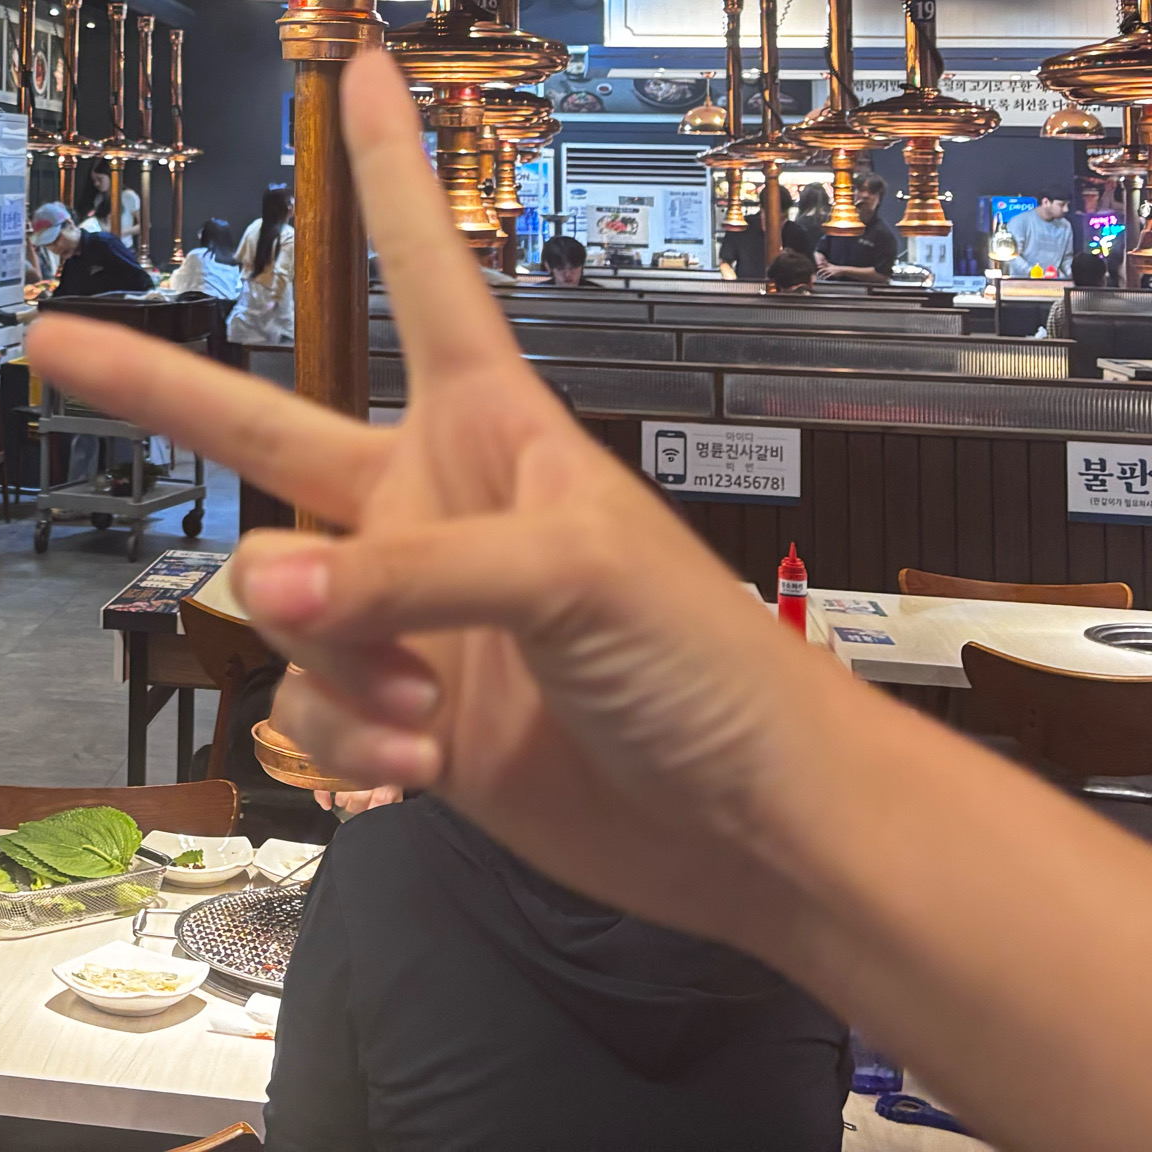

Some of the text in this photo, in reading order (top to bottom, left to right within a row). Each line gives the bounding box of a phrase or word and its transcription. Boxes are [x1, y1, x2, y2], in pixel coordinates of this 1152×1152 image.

[916, 0, 935, 21] 19
[1013, 98, 1049, 112] 최선을
[695, 441, 784, 463] 명륜진사갈비
[1077, 457, 1152, 495] 불판
